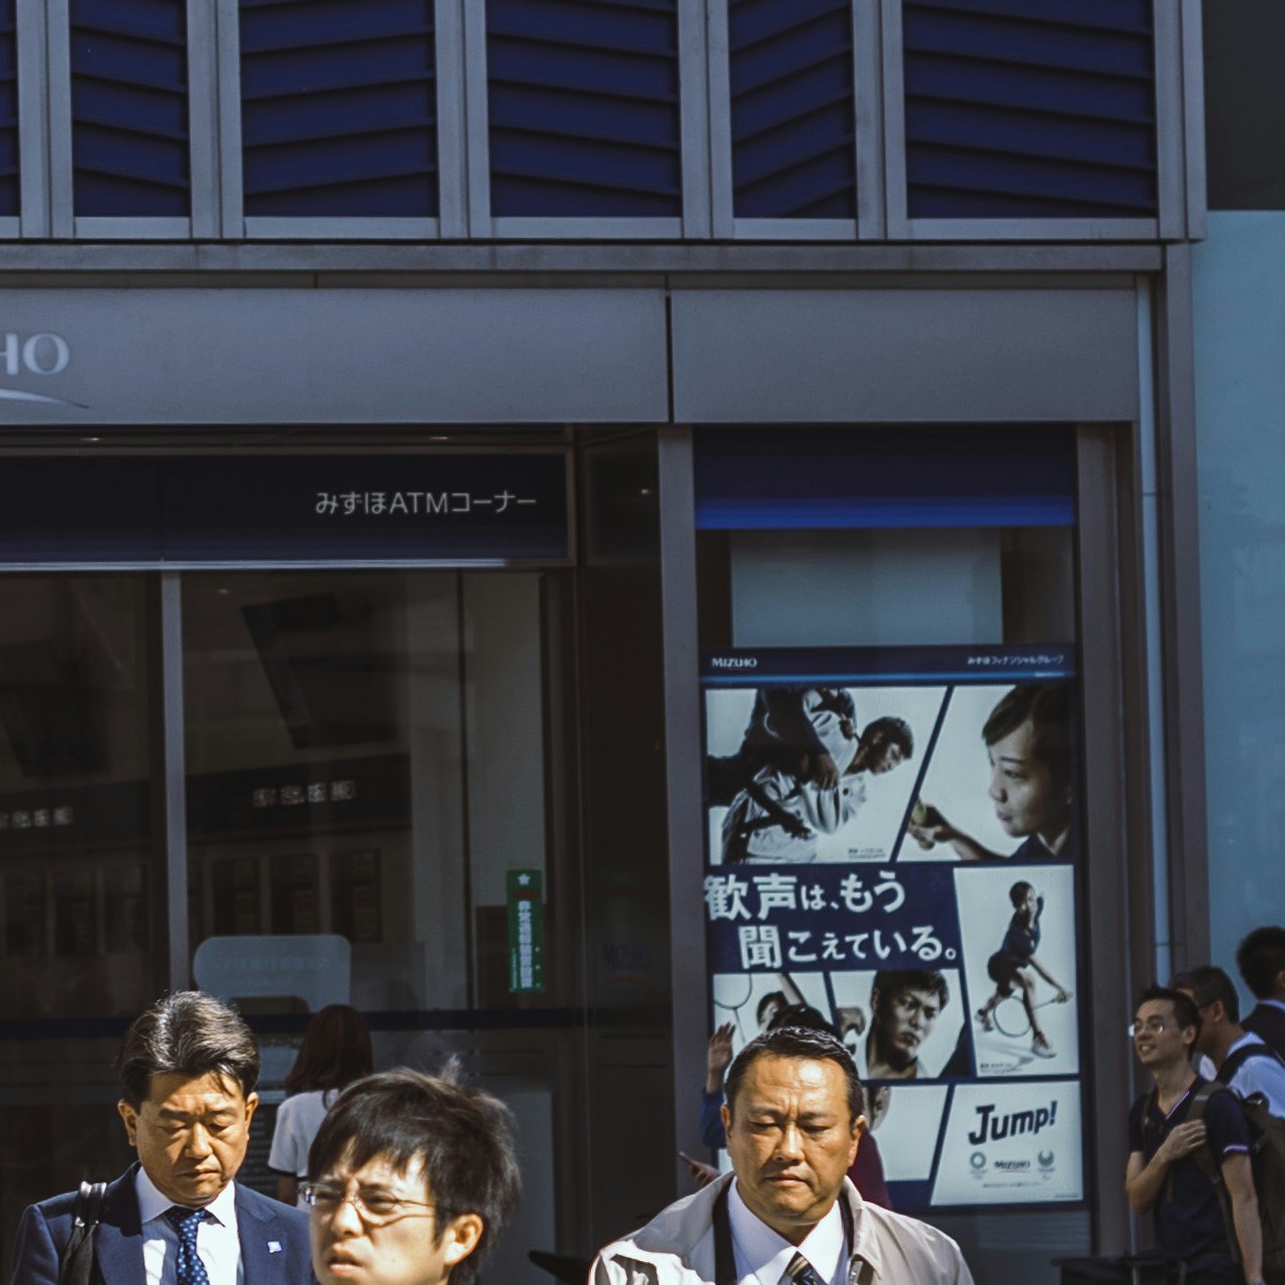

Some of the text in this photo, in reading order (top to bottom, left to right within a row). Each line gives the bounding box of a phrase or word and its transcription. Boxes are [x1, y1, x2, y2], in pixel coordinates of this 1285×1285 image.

[315, 490, 538, 515] みずほATMコーナー
[711, 657, 758, 668] MIZUHO
[704, 870, 906, 921] 歓声は、もう
[738, 925, 957, 969] 聞こえている。
[968, 1099, 1059, 1146] Jump!
